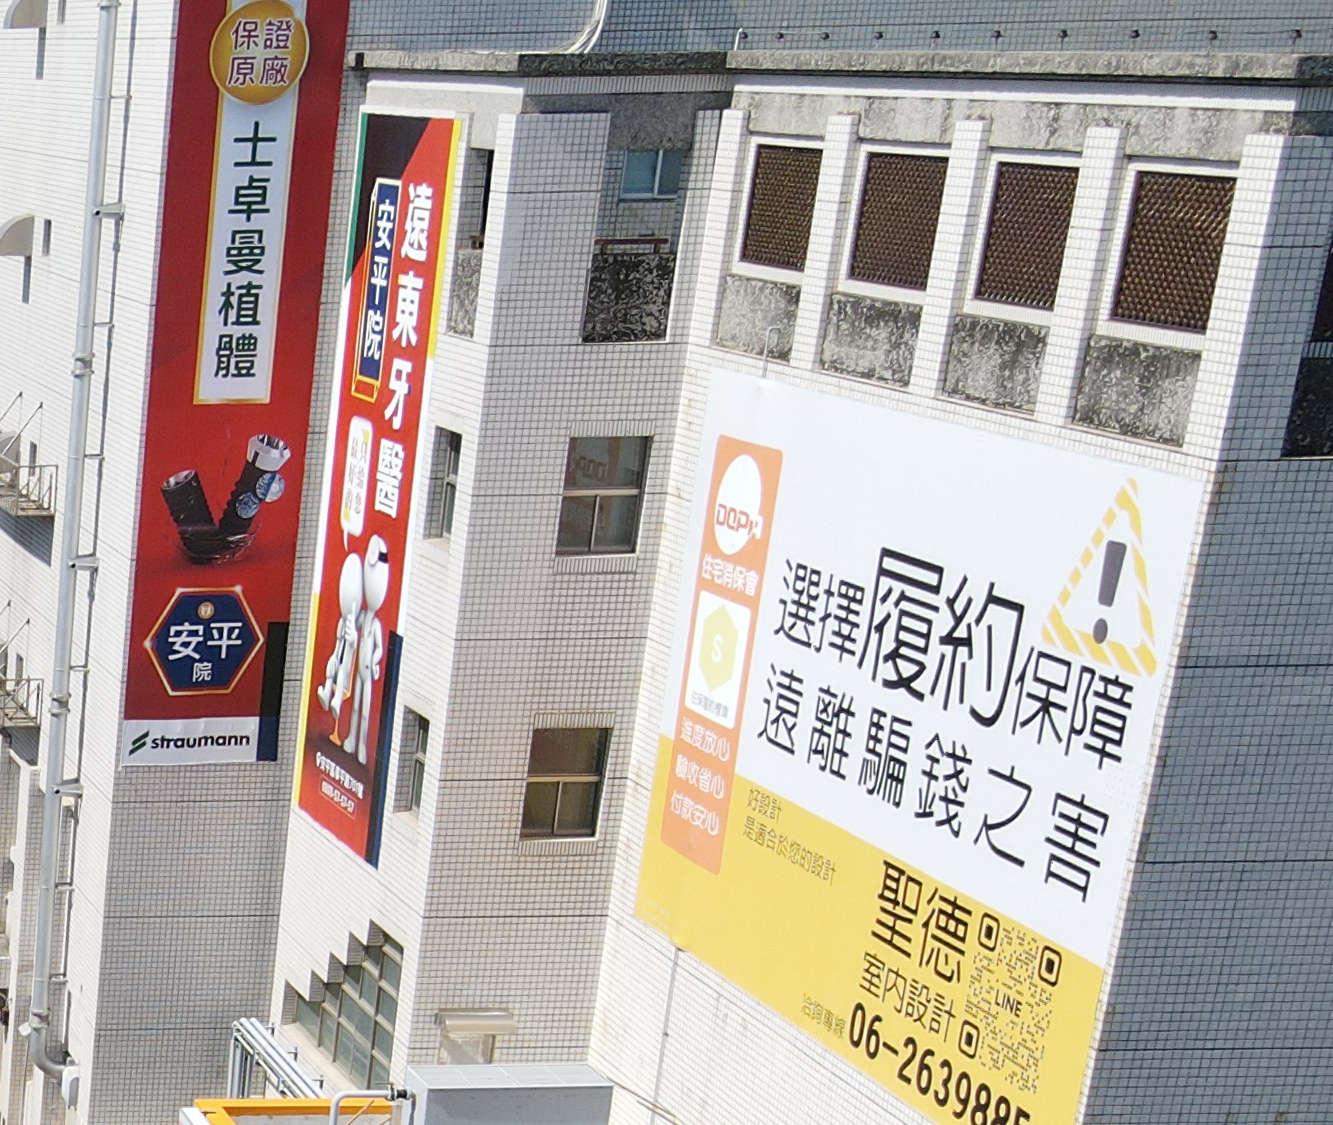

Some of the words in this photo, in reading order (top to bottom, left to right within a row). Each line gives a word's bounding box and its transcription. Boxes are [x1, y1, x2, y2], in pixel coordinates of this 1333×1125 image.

[232, 19, 294, 51] 保證
[227, 55, 289, 87] 原廠
[213, 120, 278, 380] 士卓曼植體
[363, 198, 397, 361] 安平院
[374, 182, 434, 519] 遠東牙醫
[166, 621, 243, 661] 安平
[772, 546, 1135, 769] 選擇履約保障
[192, 661, 213, 683] 院
[151, 732, 250, 750] straumann
[746, 785, 782, 824] 好設計
[757, 662, 1110, 903] 遠離騙錢之害
[670, 789, 720, 836] 付款安心
[742, 815, 837, 887] 是適合於您的設計
[870, 858, 974, 985] 聖德
[858, 950, 957, 1044] 室內設計
[992, 988, 1023, 1019] LINE
